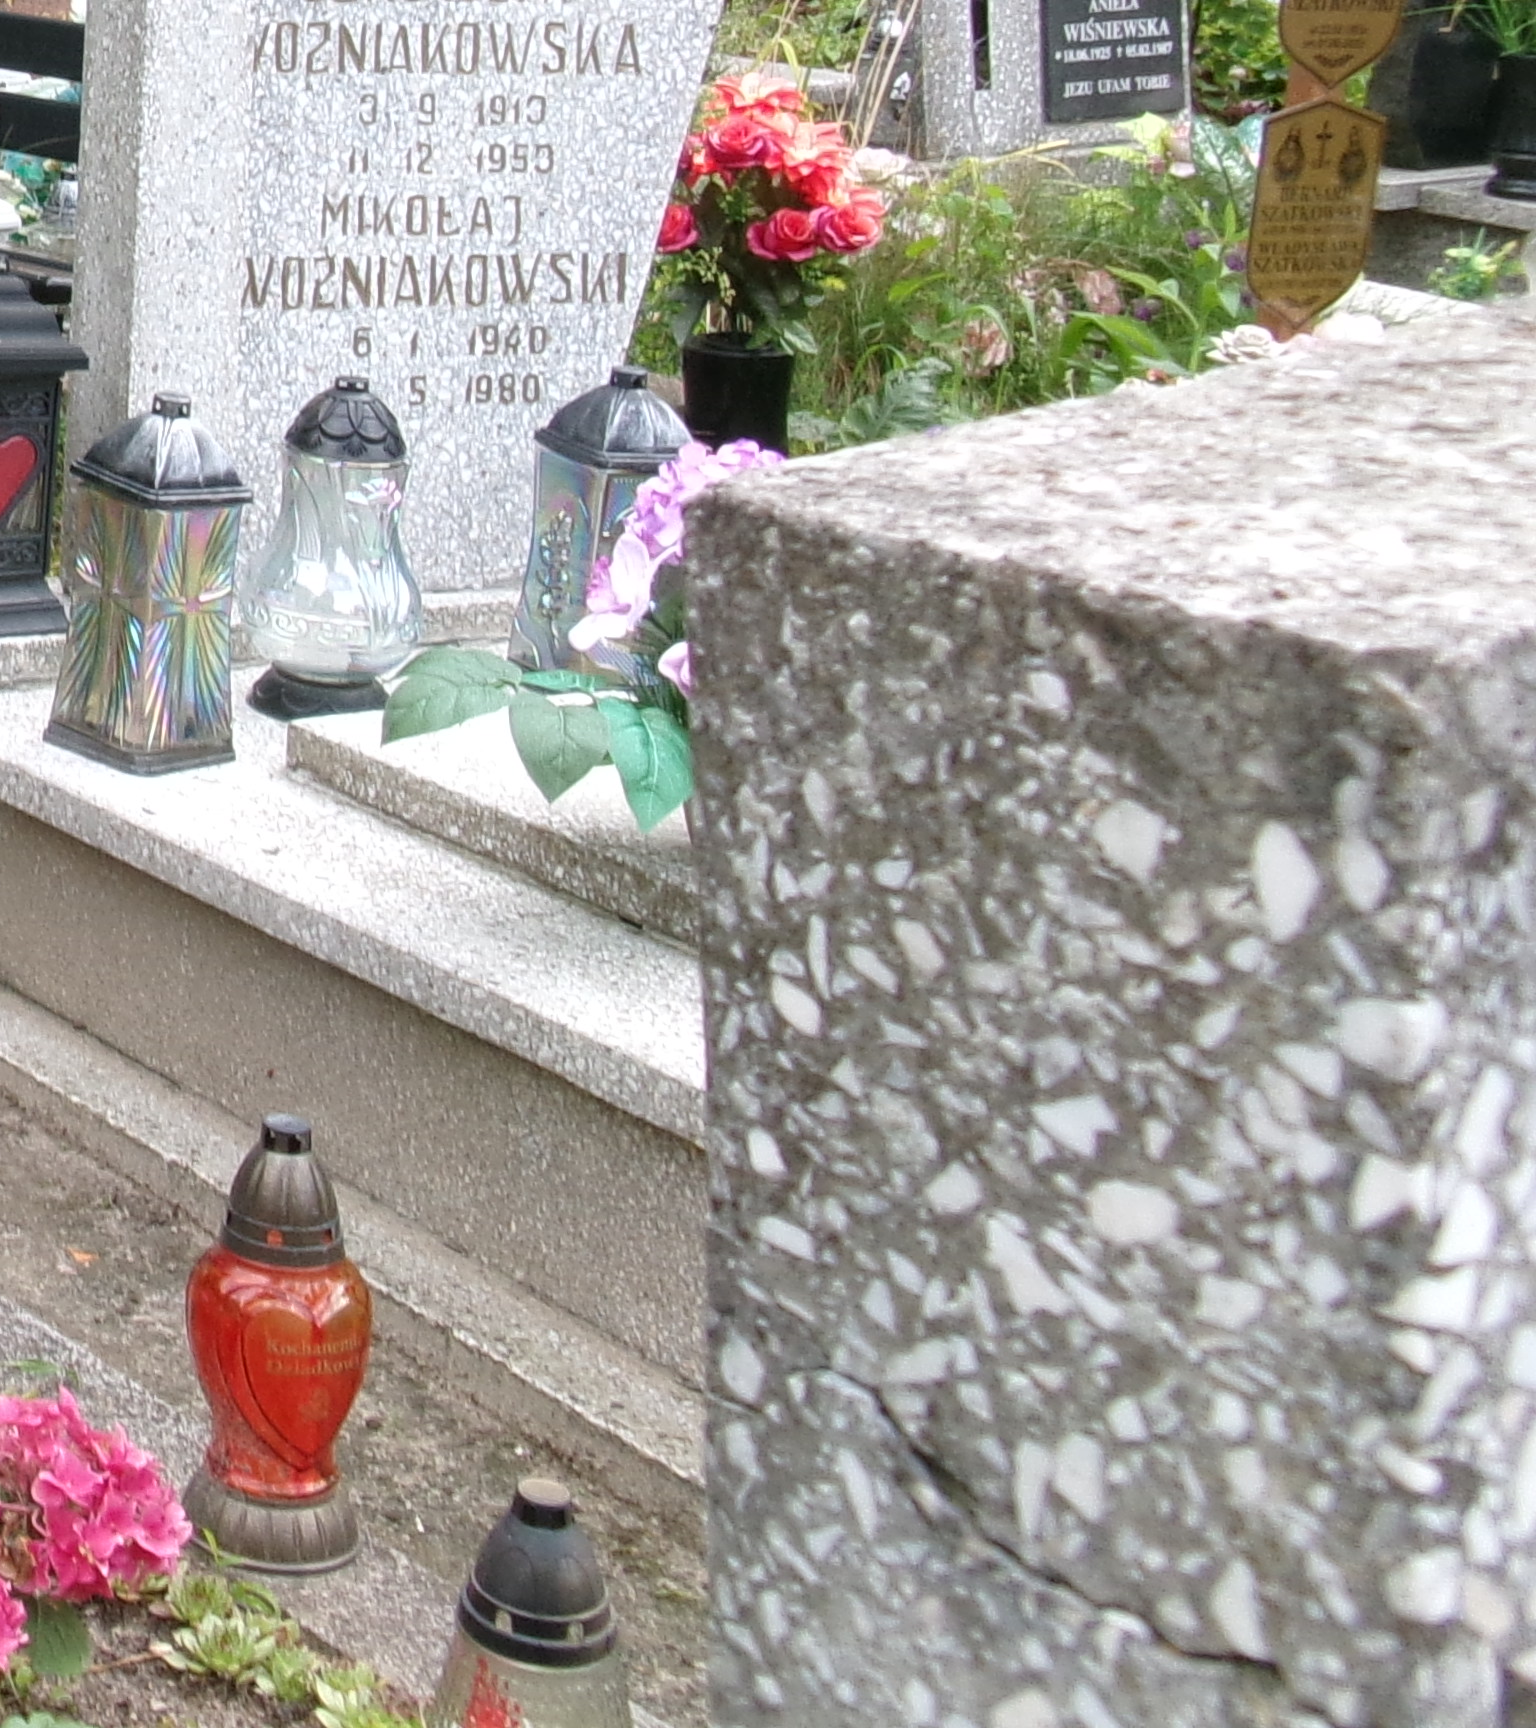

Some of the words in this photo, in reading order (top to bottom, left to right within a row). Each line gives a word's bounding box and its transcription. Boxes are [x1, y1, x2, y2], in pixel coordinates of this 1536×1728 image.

[1063, 17, 1170, 42] WIŚNIEWSKA
[1063, 81, 1093, 98] JEZU
[1098, 77, 1131, 93] UFAM
[1135, 74, 1171, 90] TOBIE
[419, 93, 437, 126] 9
[348, 147, 370, 174] 11
[405, 143, 434, 174] 12
[476, 143, 555, 173] 1953
[321, 194, 523, 246] MIKOŁAJ
[353, 326, 372, 357] 6
[469, 325, 548, 356] 1940
[409, 376, 428, 405] 5
[466, 373, 542, 403] 1980
